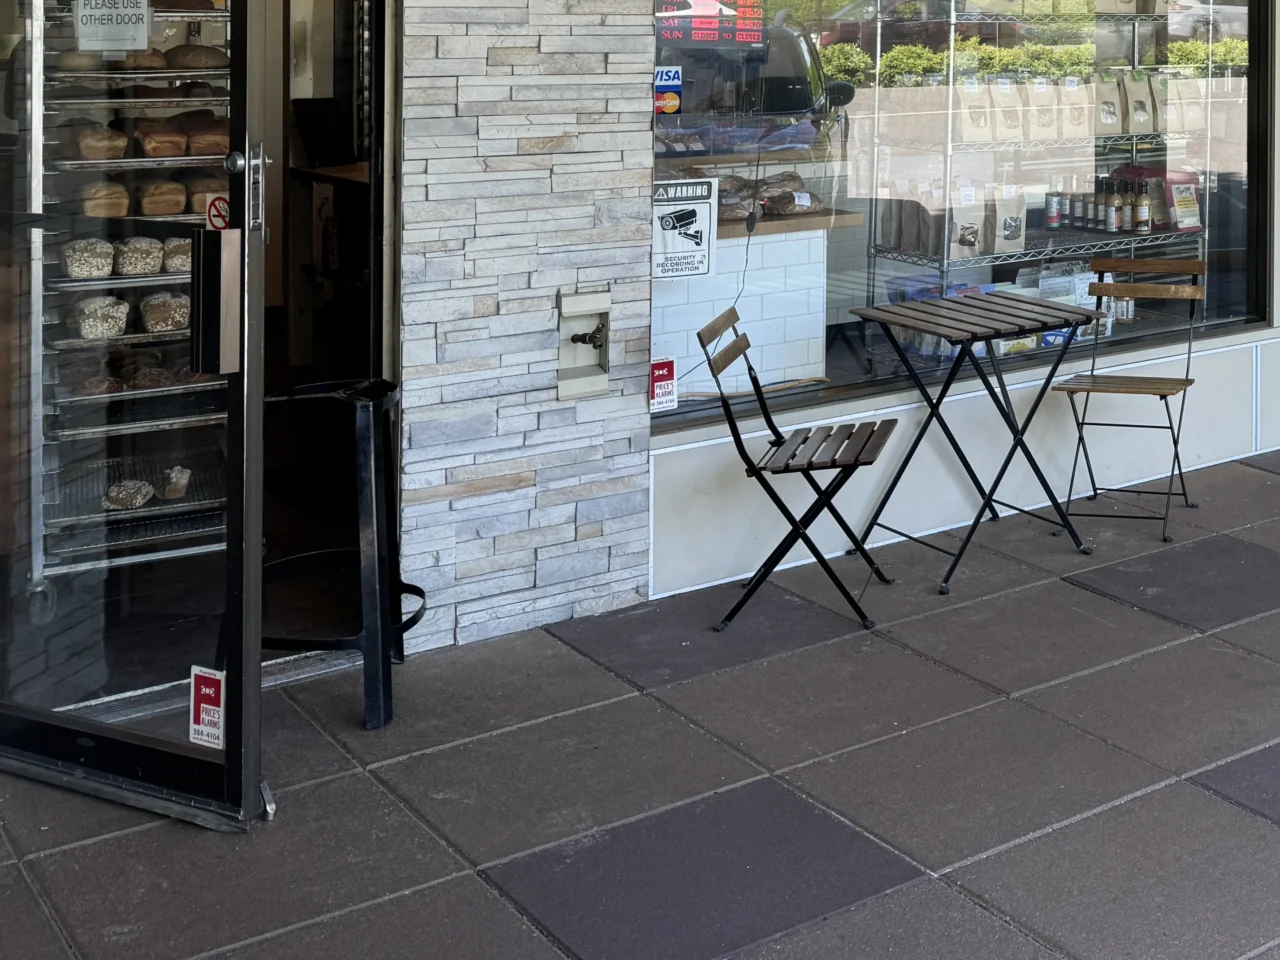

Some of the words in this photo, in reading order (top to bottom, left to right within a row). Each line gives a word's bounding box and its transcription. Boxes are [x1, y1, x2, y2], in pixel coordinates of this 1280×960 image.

[81, 14, 114, 25] OTHER
[115, 13, 145, 25] DOOR
[662, 18, 679, 27] SAT
[662, 30, 683, 39] SUN
[693, 31, 717, 40] CLOSED
[737, 33, 760, 41] CLOSED
[667, 185, 708, 198] WARNING
[664, 254, 696, 262] SECURITY
[656, 260, 696, 269] RECORDING
[661, 266, 700, 274] OPERATION
[201, 706, 220, 720] PRICE'S
[193, 728, 220, 741] 384-4104
